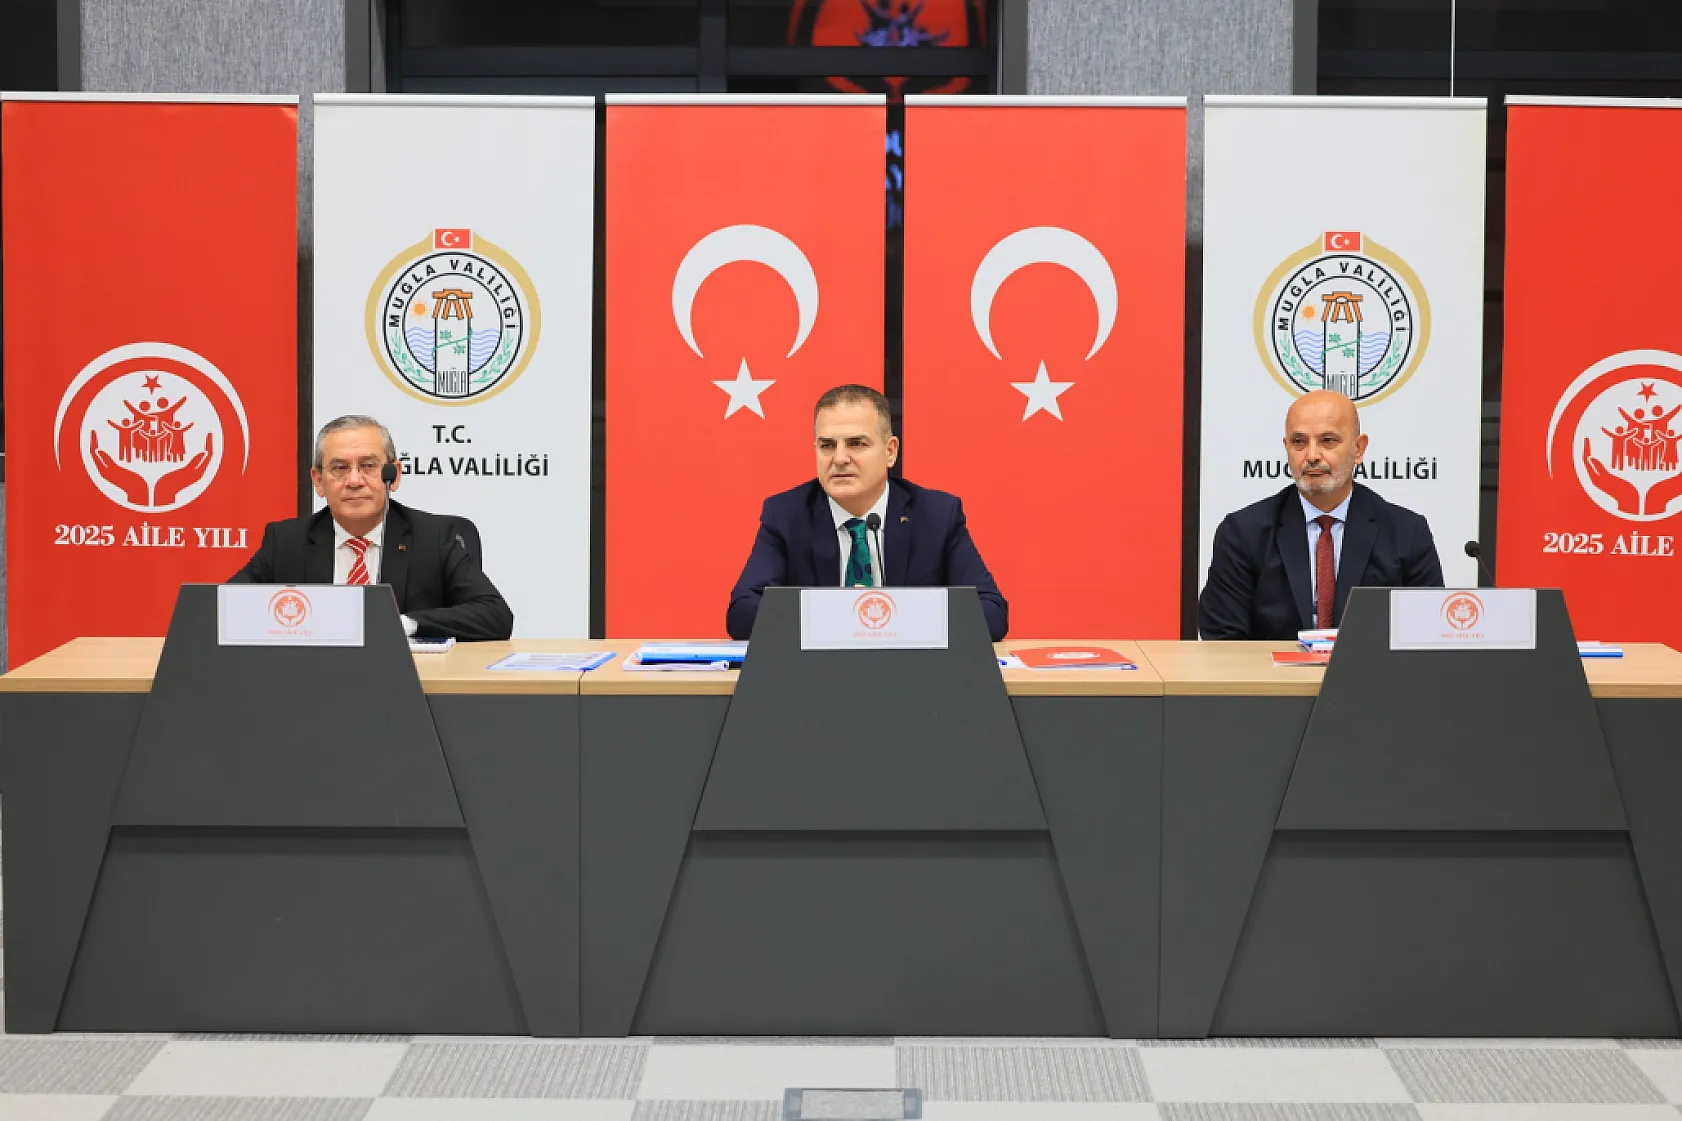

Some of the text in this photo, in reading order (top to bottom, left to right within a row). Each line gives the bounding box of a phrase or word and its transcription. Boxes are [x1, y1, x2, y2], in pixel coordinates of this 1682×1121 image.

[432, 424, 472, 444] T.C.
[399, 452, 549, 477] ĞLA VALİLİĞİ
[1353, 456, 1437, 480] ALİLİĞİ
[54, 521, 249, 548] 2025 AİLE YILI
[1543, 530, 1675, 557] 2025 AİLE
